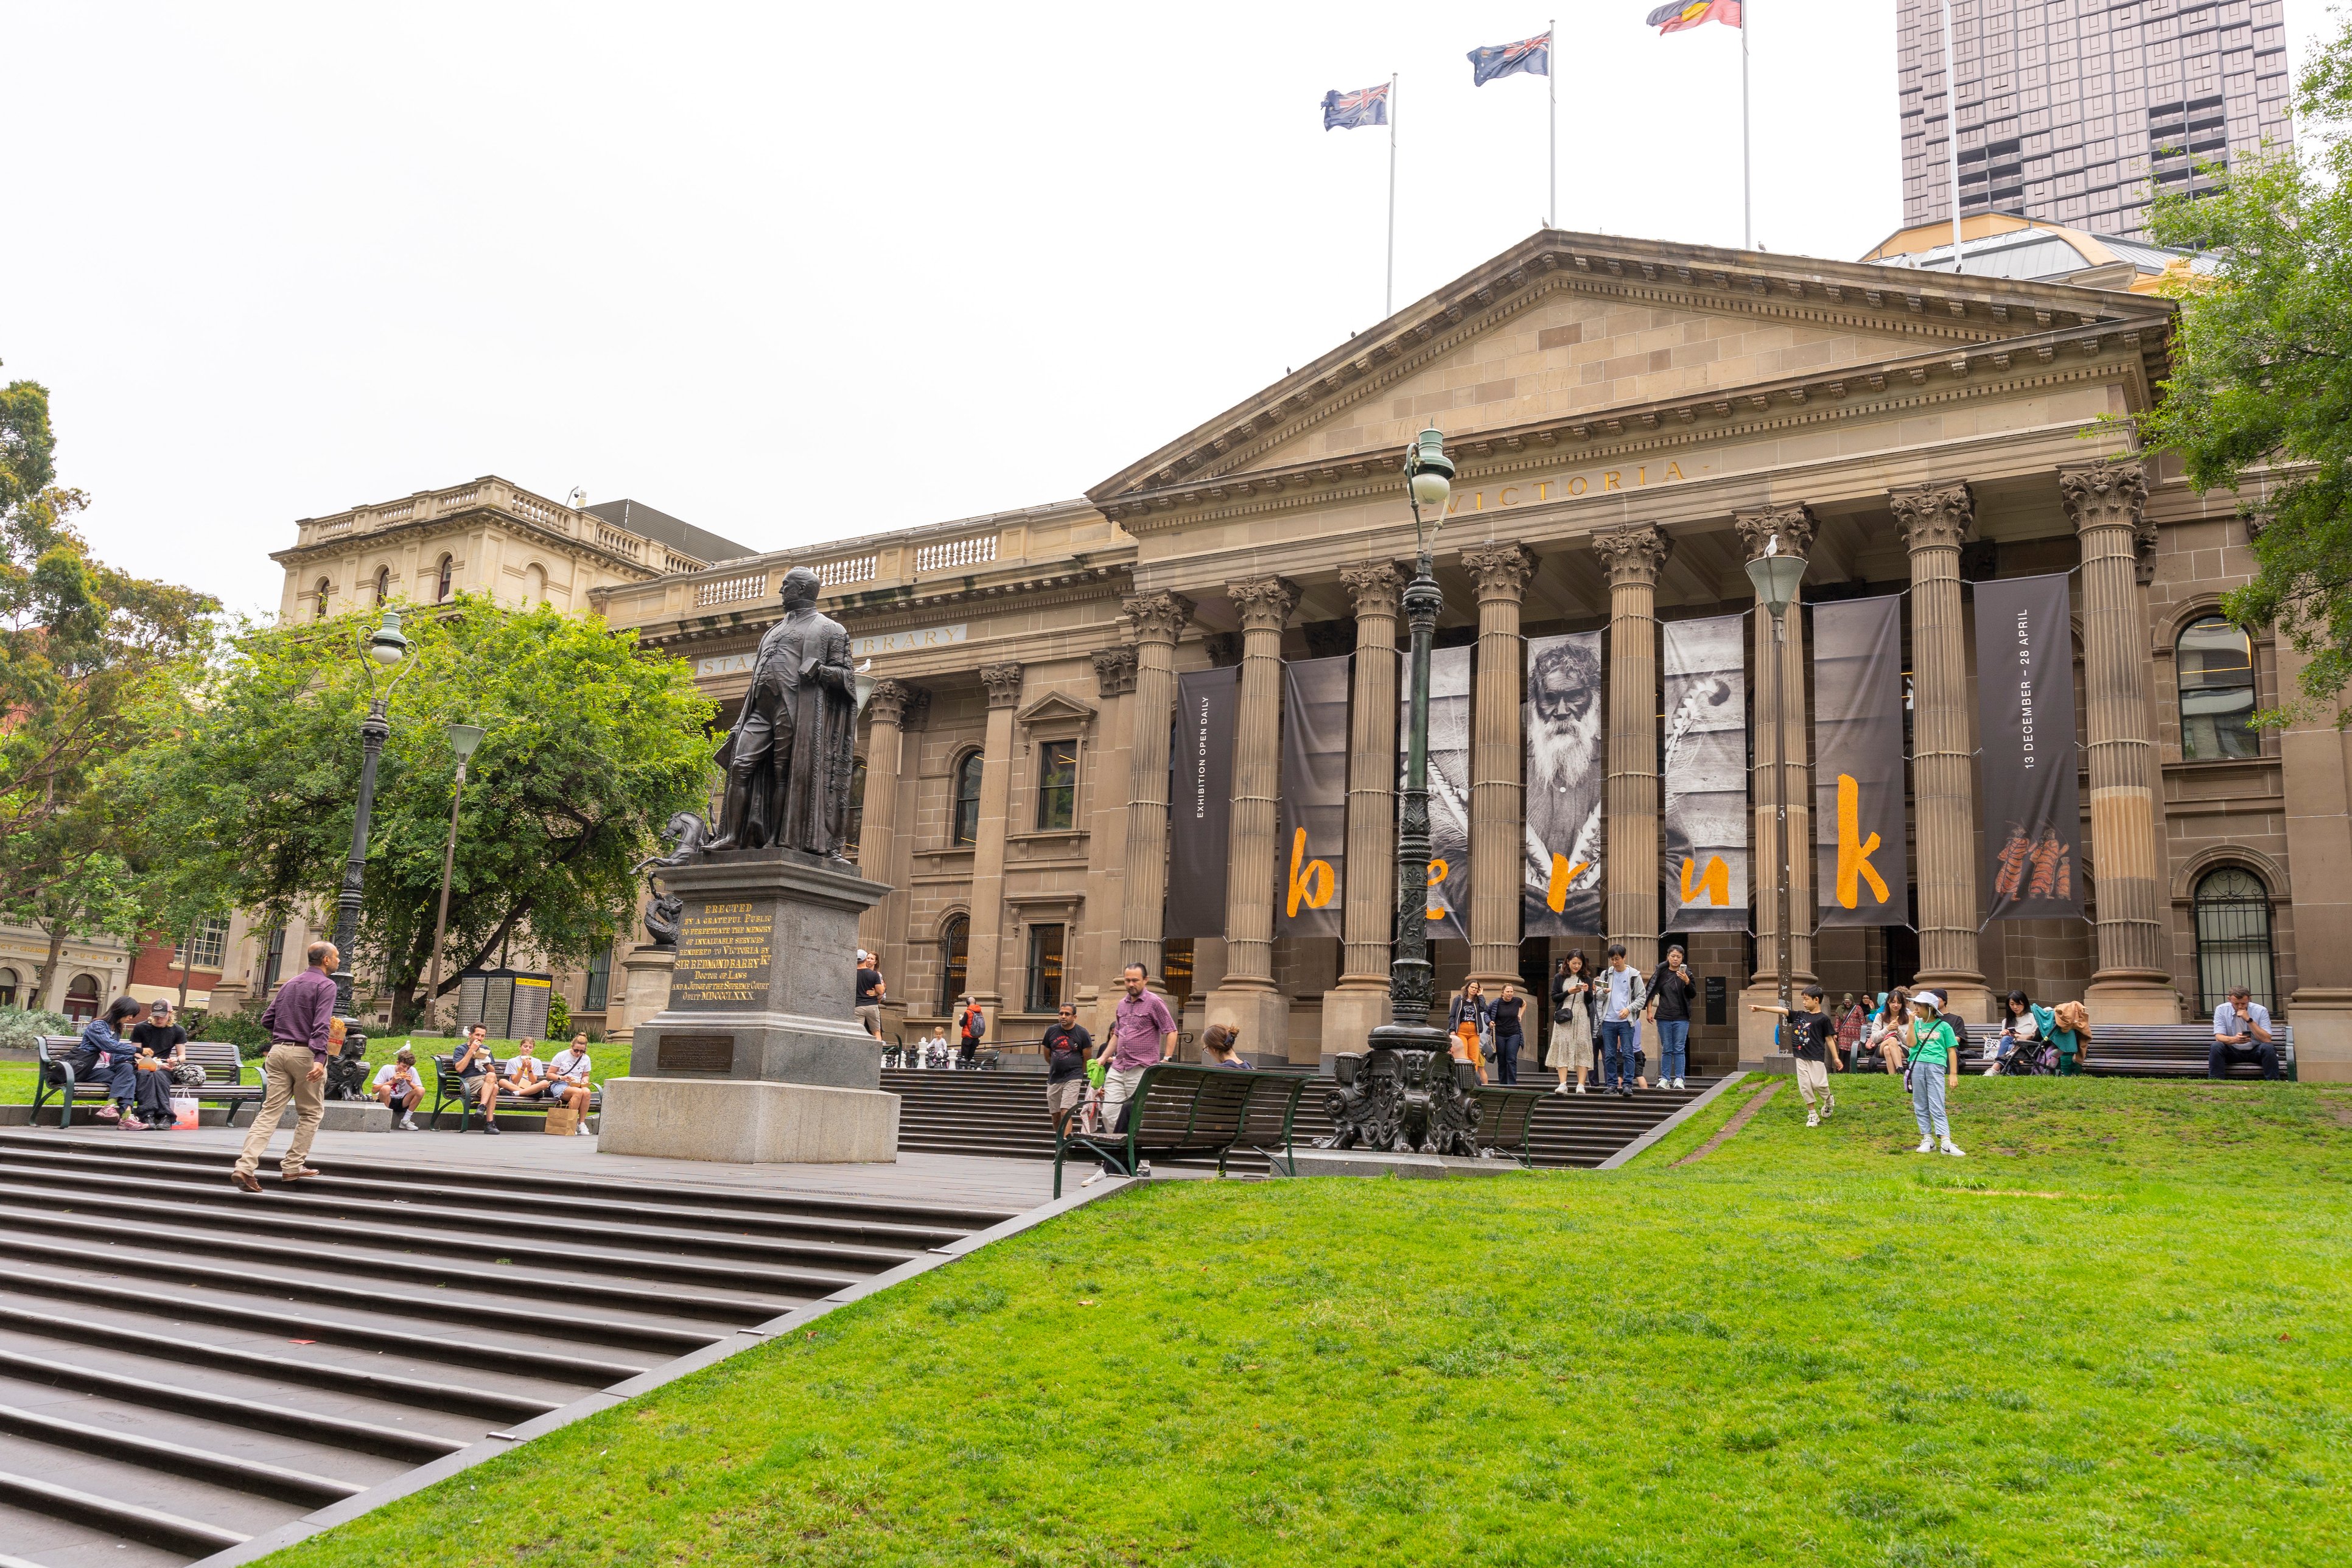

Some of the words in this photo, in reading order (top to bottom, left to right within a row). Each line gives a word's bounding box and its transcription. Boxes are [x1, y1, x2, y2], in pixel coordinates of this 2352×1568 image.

[1442, 461, 1685, 514] VICTORIA
[2018, 609, 2029, 645] APRIL
[703, 655, 757, 674] STA
[850, 627, 960, 654] IBRARY
[2020, 650, 2030, 664] 28
[1200, 697, 1209, 724] DAILY
[2021, 681, 2034, 751] DECEMBER
[2025, 756, 2034, 769] 13
[1197, 760, 1206, 818] EXHIBITION
[704, 903, 752, 914] ERECTED
[703, 916, 742, 925] GRATEFUL
[744, 914, 772, 923] PUBLIC
[19, 945, 62, 955] CHAMBES
[723, 945, 759, 954] VICTORIA
[674, 959, 690, 970] SIR
[690, 959, 729, 969] REDMOND
[729, 958, 760, 968] BARRY
[694, 970, 718, 980] DOCTOR
[727, 970, 747, 979] LAWS
[687, 981, 706, 990] JUDGE
[724, 981, 751, 990] SUPREME
[751, 981, 770, 990] COURT
[701, 991, 755, 1001] MDCCCLXXX
